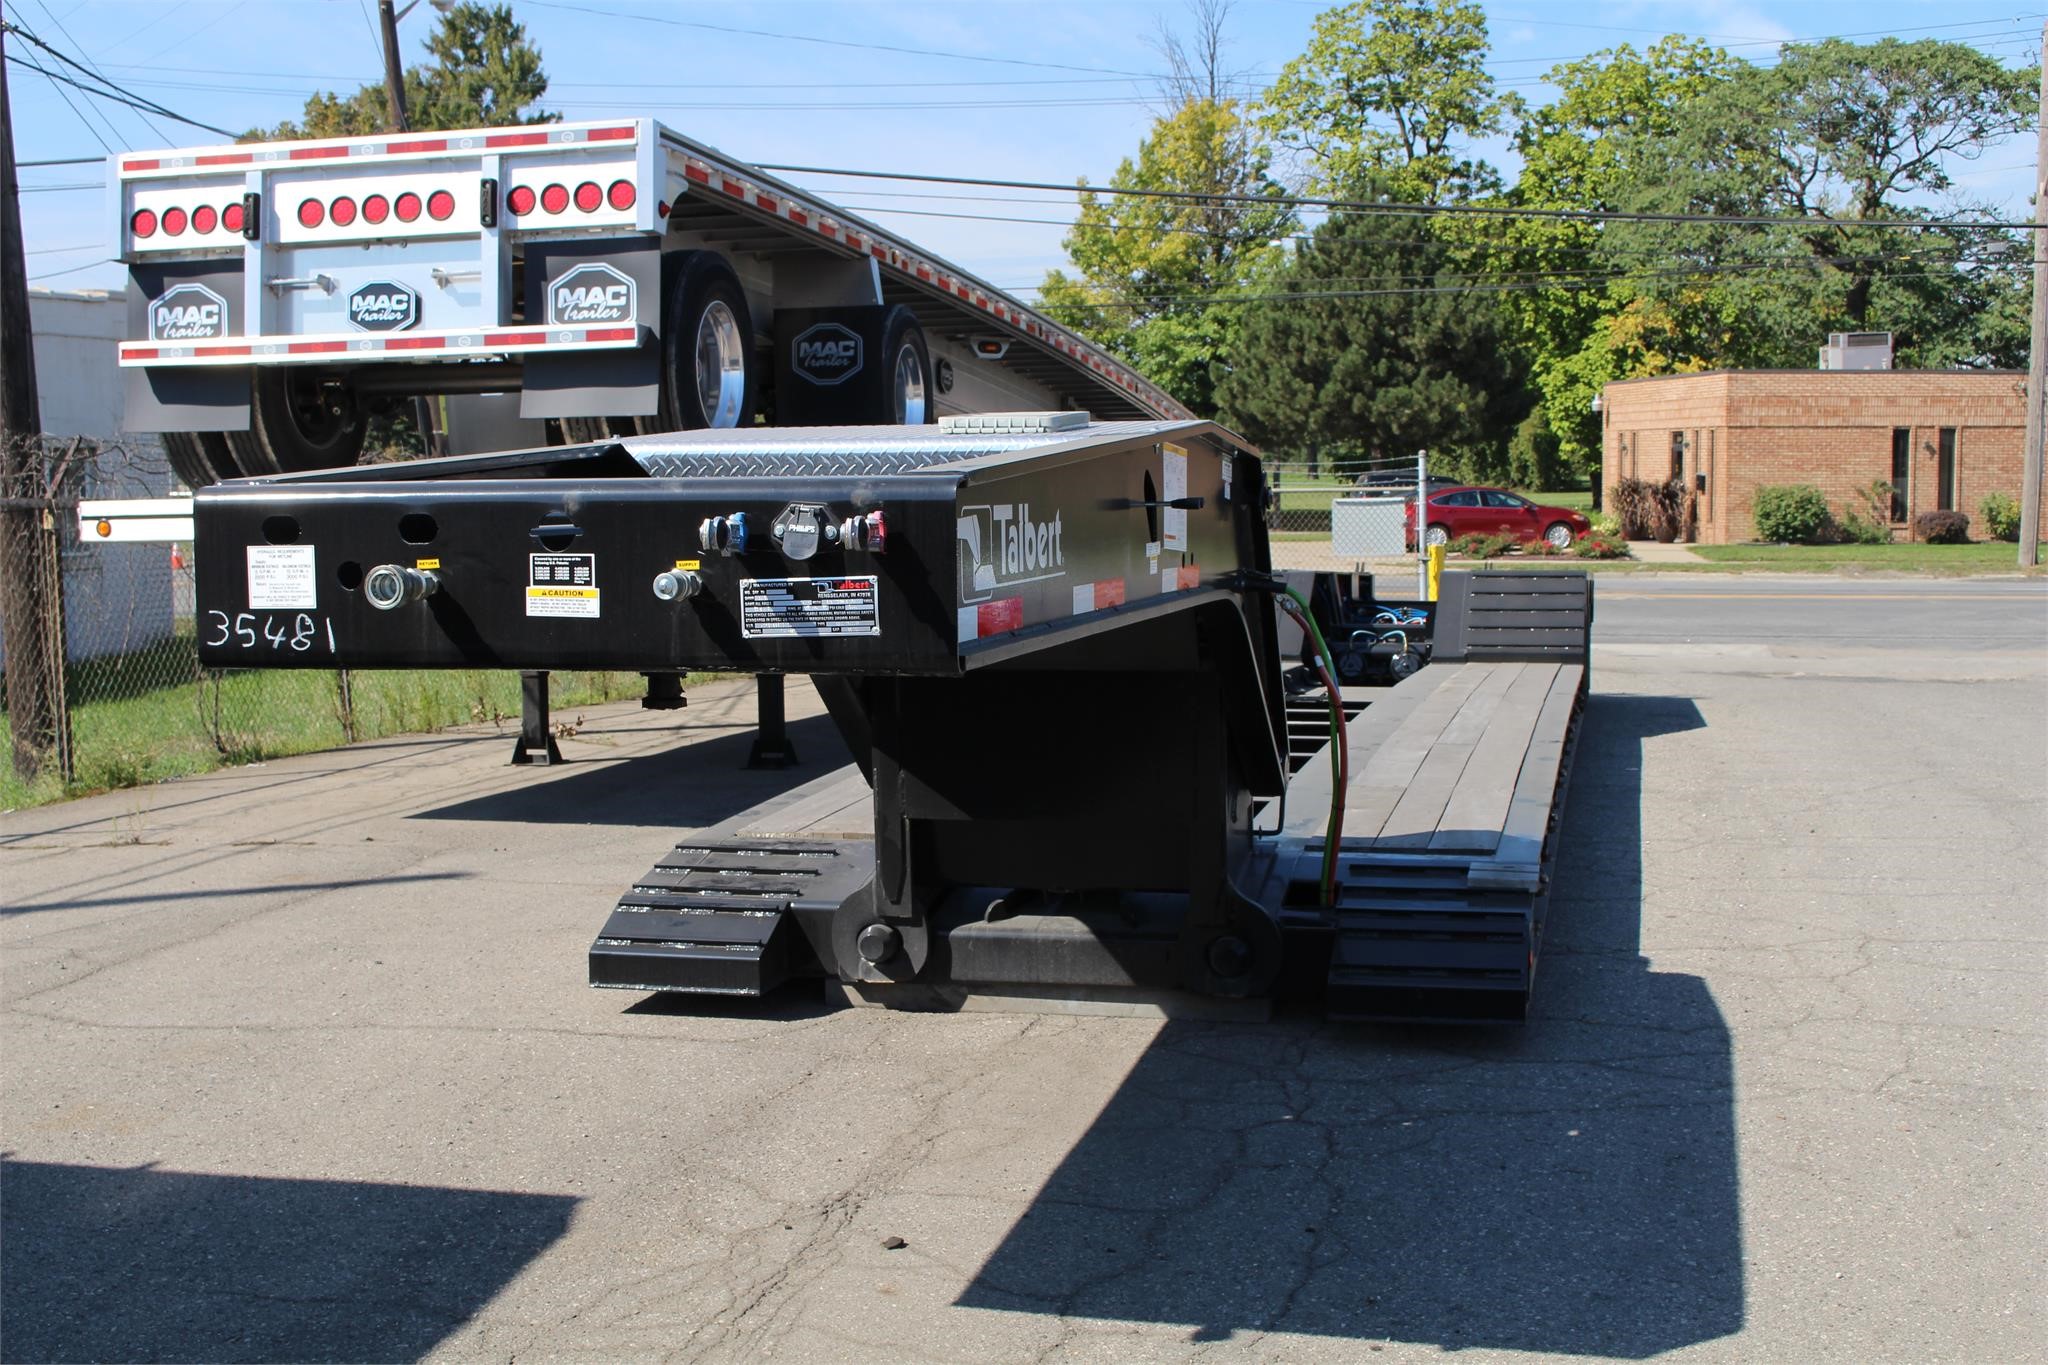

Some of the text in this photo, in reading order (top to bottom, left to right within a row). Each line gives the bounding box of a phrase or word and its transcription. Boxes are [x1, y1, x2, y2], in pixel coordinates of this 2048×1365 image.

[351, 294, 408, 311] MAC
[557, 285, 628, 308] MAC
[156, 304, 220, 326] MAC
[355, 305, 404, 322] Trailer
[563, 301, 621, 321] Trailer
[162, 320, 214, 339] Trailer
[799, 340, 856, 358] MAC
[804, 354, 850, 368] Trailer
[993, 503, 1063, 576] Talbert
[206, 610, 336, 654] 35481
